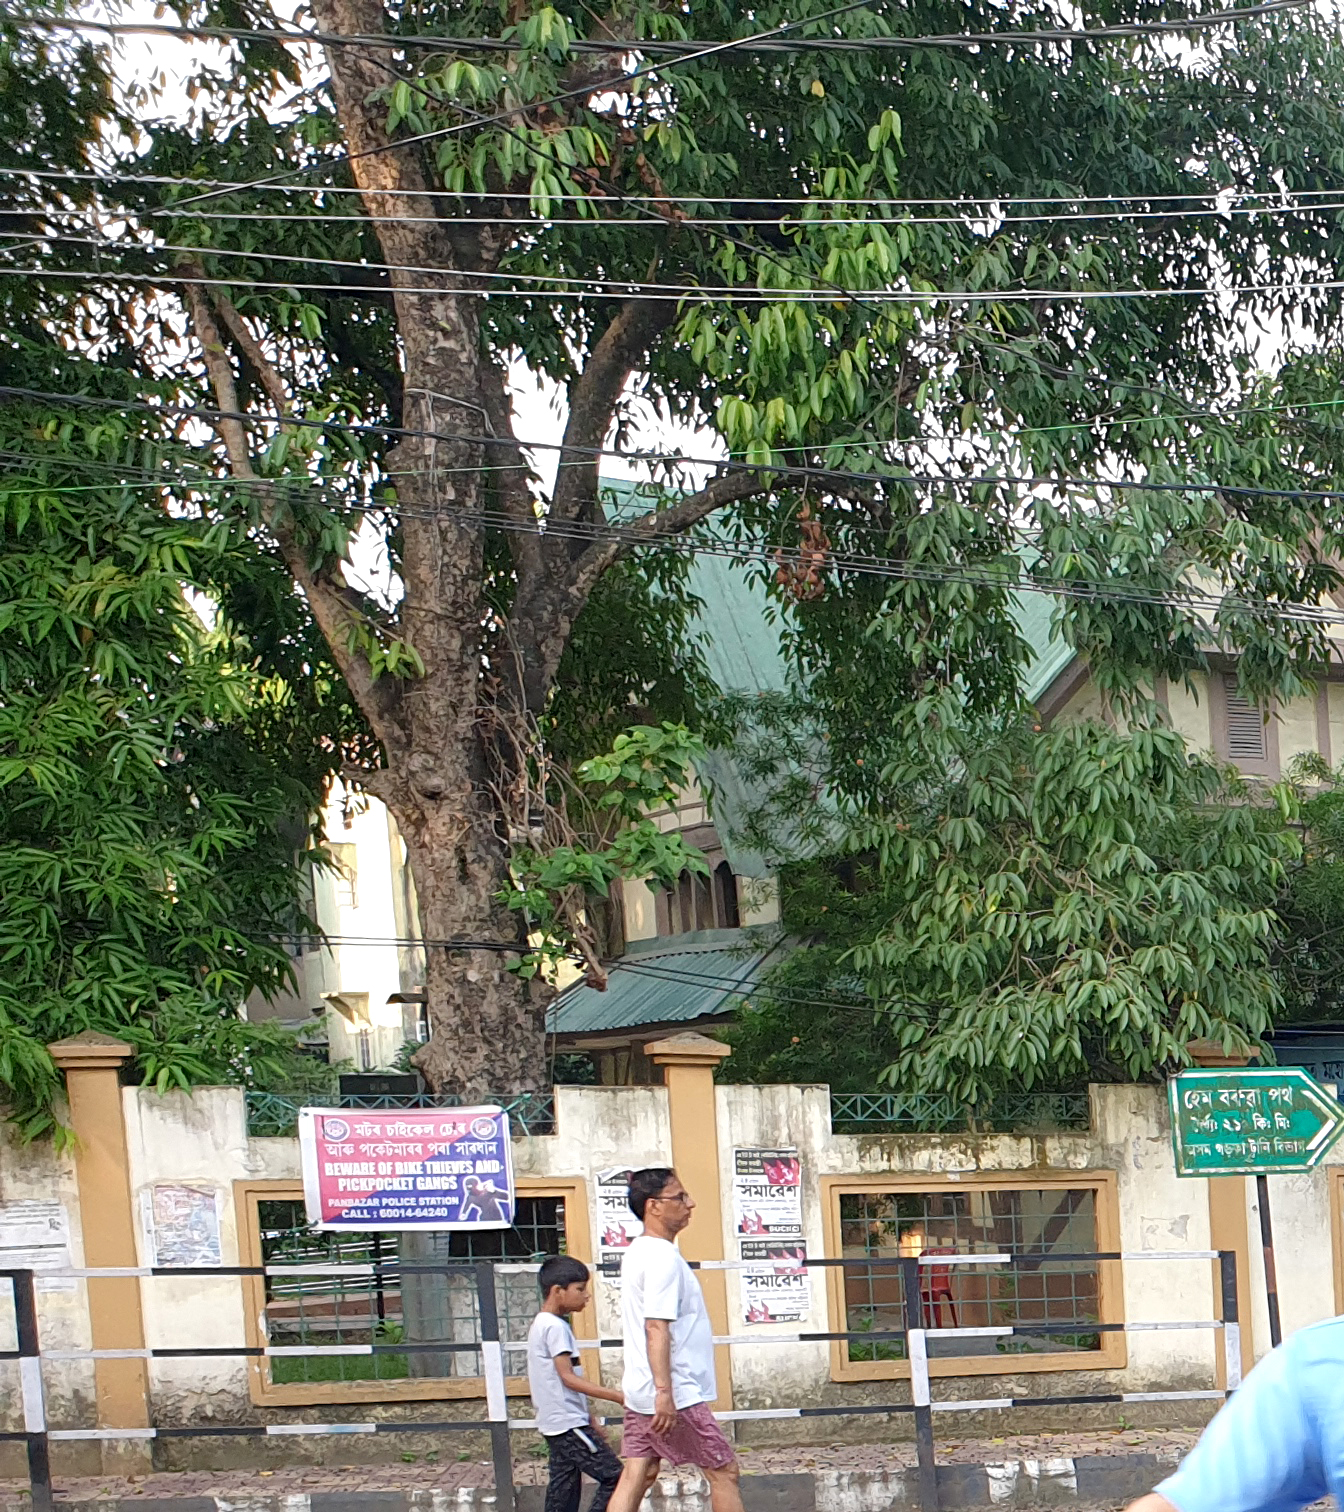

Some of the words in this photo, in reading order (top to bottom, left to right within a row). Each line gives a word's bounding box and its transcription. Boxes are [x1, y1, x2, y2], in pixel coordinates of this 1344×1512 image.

[325, 1162, 376, 1176] BEWARE
[378, 1162, 393, 1175] OF
[395, 1162, 424, 1175] BIKE
[425, 1161, 474, 1175] THIEVES
[338, 1177, 414, 1191] PICKPOCKET
[416, 1176, 458, 1190] GANGS
[382, 1197, 416, 1206] POLICE
[419, 1196, 459, 1205] STATION
[341, 1209, 371, 1218] CALL
